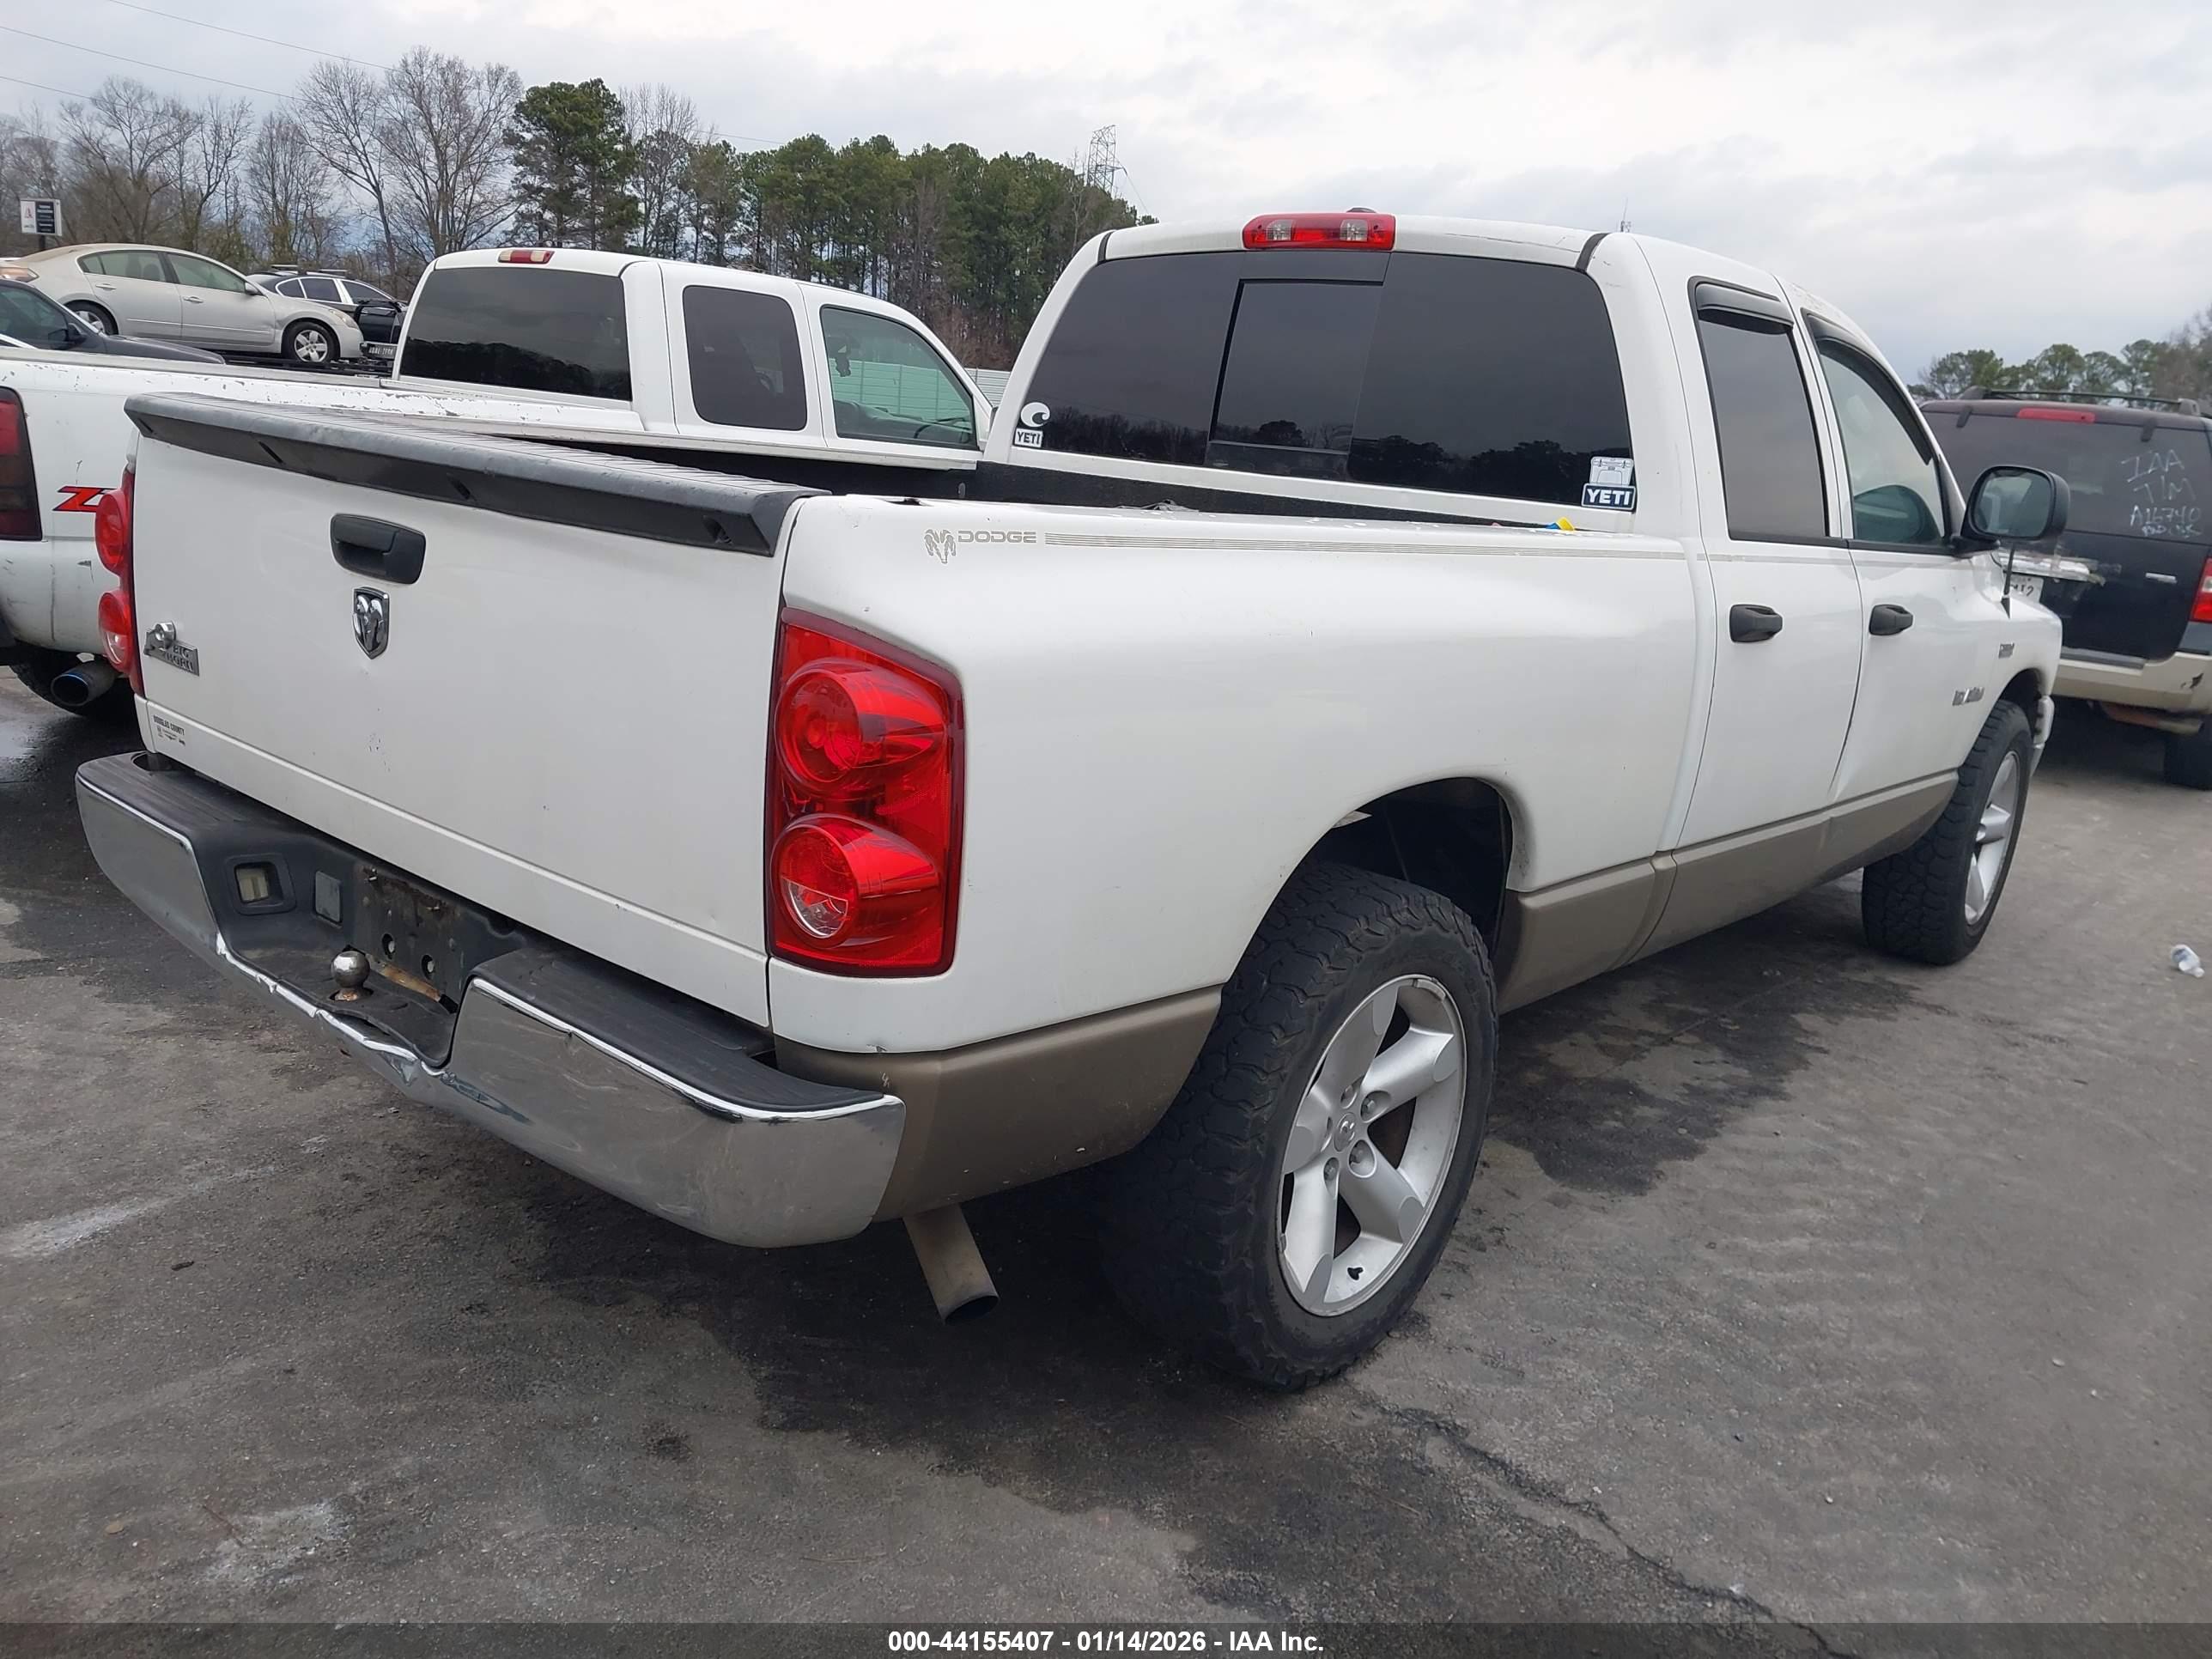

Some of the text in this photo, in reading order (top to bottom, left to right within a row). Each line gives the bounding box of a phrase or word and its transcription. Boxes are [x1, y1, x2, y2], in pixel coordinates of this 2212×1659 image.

[1017, 431, 1041, 445] YETI
[1586, 488, 1632, 506] YETI
[957, 530, 1037, 543] DODGE
[173, 644, 191, 659] BIG
